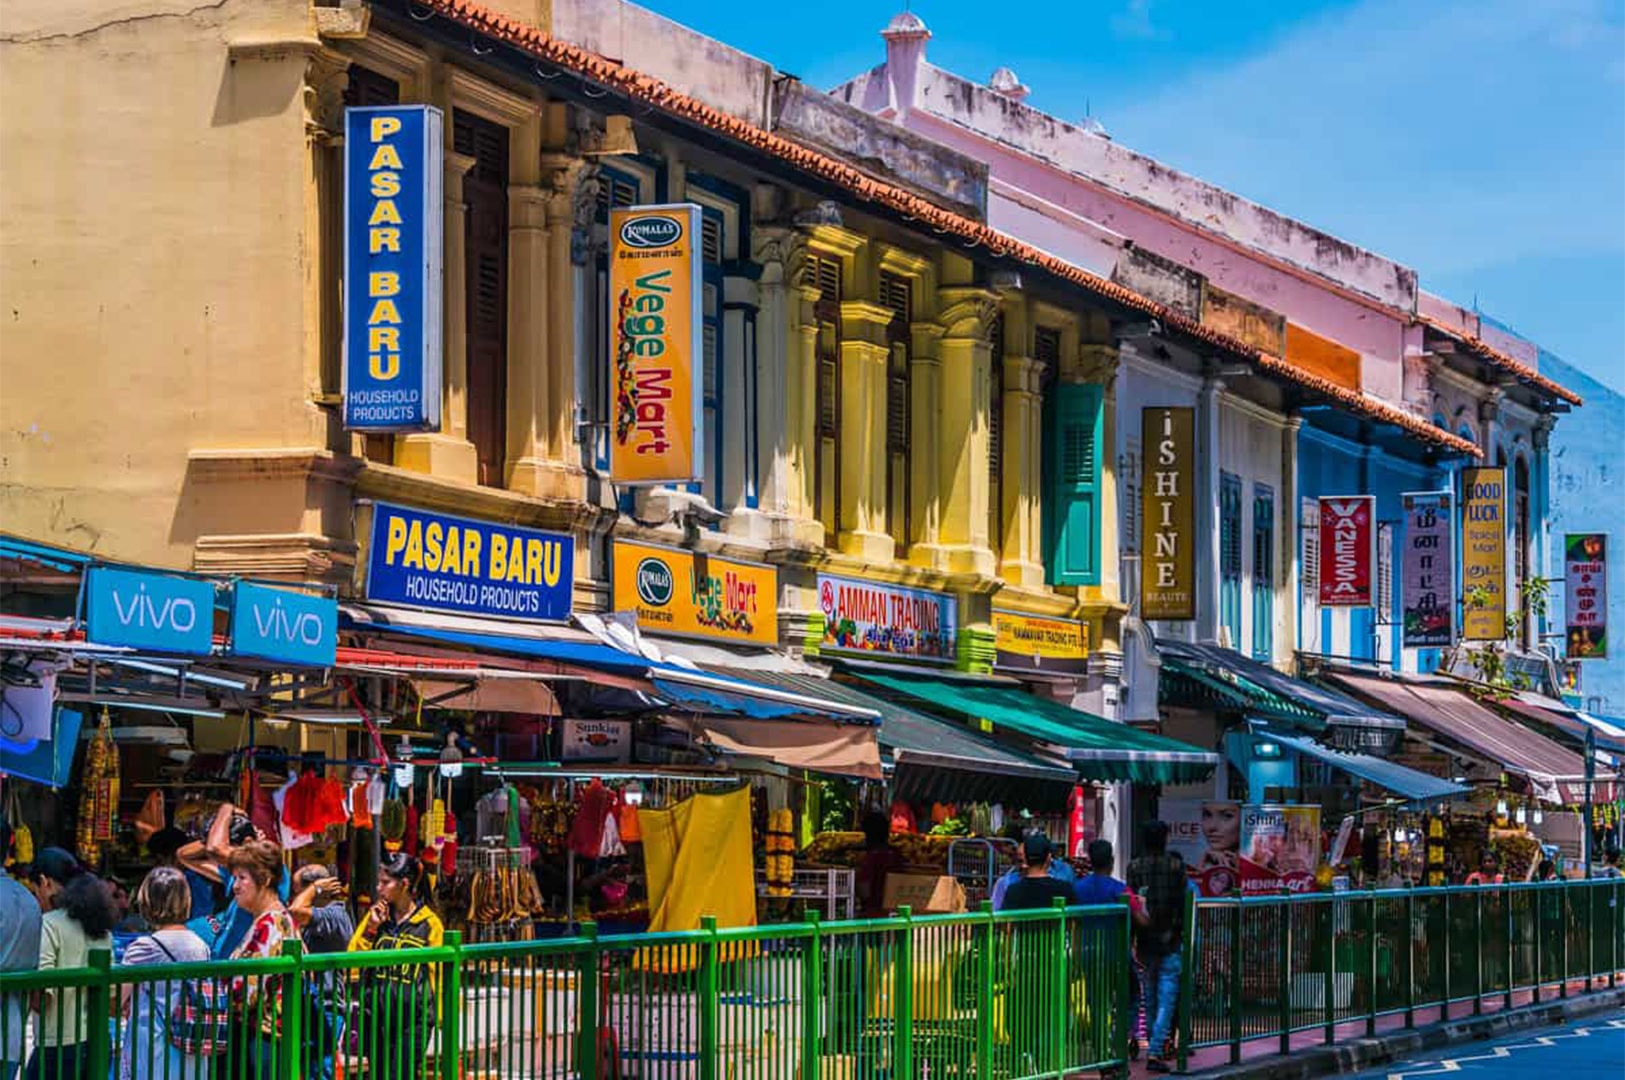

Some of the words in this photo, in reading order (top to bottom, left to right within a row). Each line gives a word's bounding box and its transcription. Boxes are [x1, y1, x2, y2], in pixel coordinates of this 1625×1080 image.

[368, 116, 404, 254] PASAR
[368, 271, 402, 381] BARU
[624, 269, 672, 358] Vege
[350, 390, 419, 405] HOUSEHOLD
[353, 406, 415, 421] PRODUCTS
[635, 368, 673, 454] Mart
[1154, 411, 1179, 588] iSHINE
[1466, 484, 1500, 500] GOOD
[1468, 505, 1499, 521] LUCK
[386, 516, 482, 577] PASAR
[489, 533, 561, 587] BARU
[1326, 500, 1363, 593] VANESSA
[113, 583, 196, 632] vivo
[406, 575, 478, 606] HOUSEHOLD
[480, 586, 540, 613] PRODUCTS
[725, 571, 757, 613] Mart
[837, 585, 887, 627] AMMAN
[890, 594, 940, 633] TRADING
[254, 597, 322, 645] vivo
